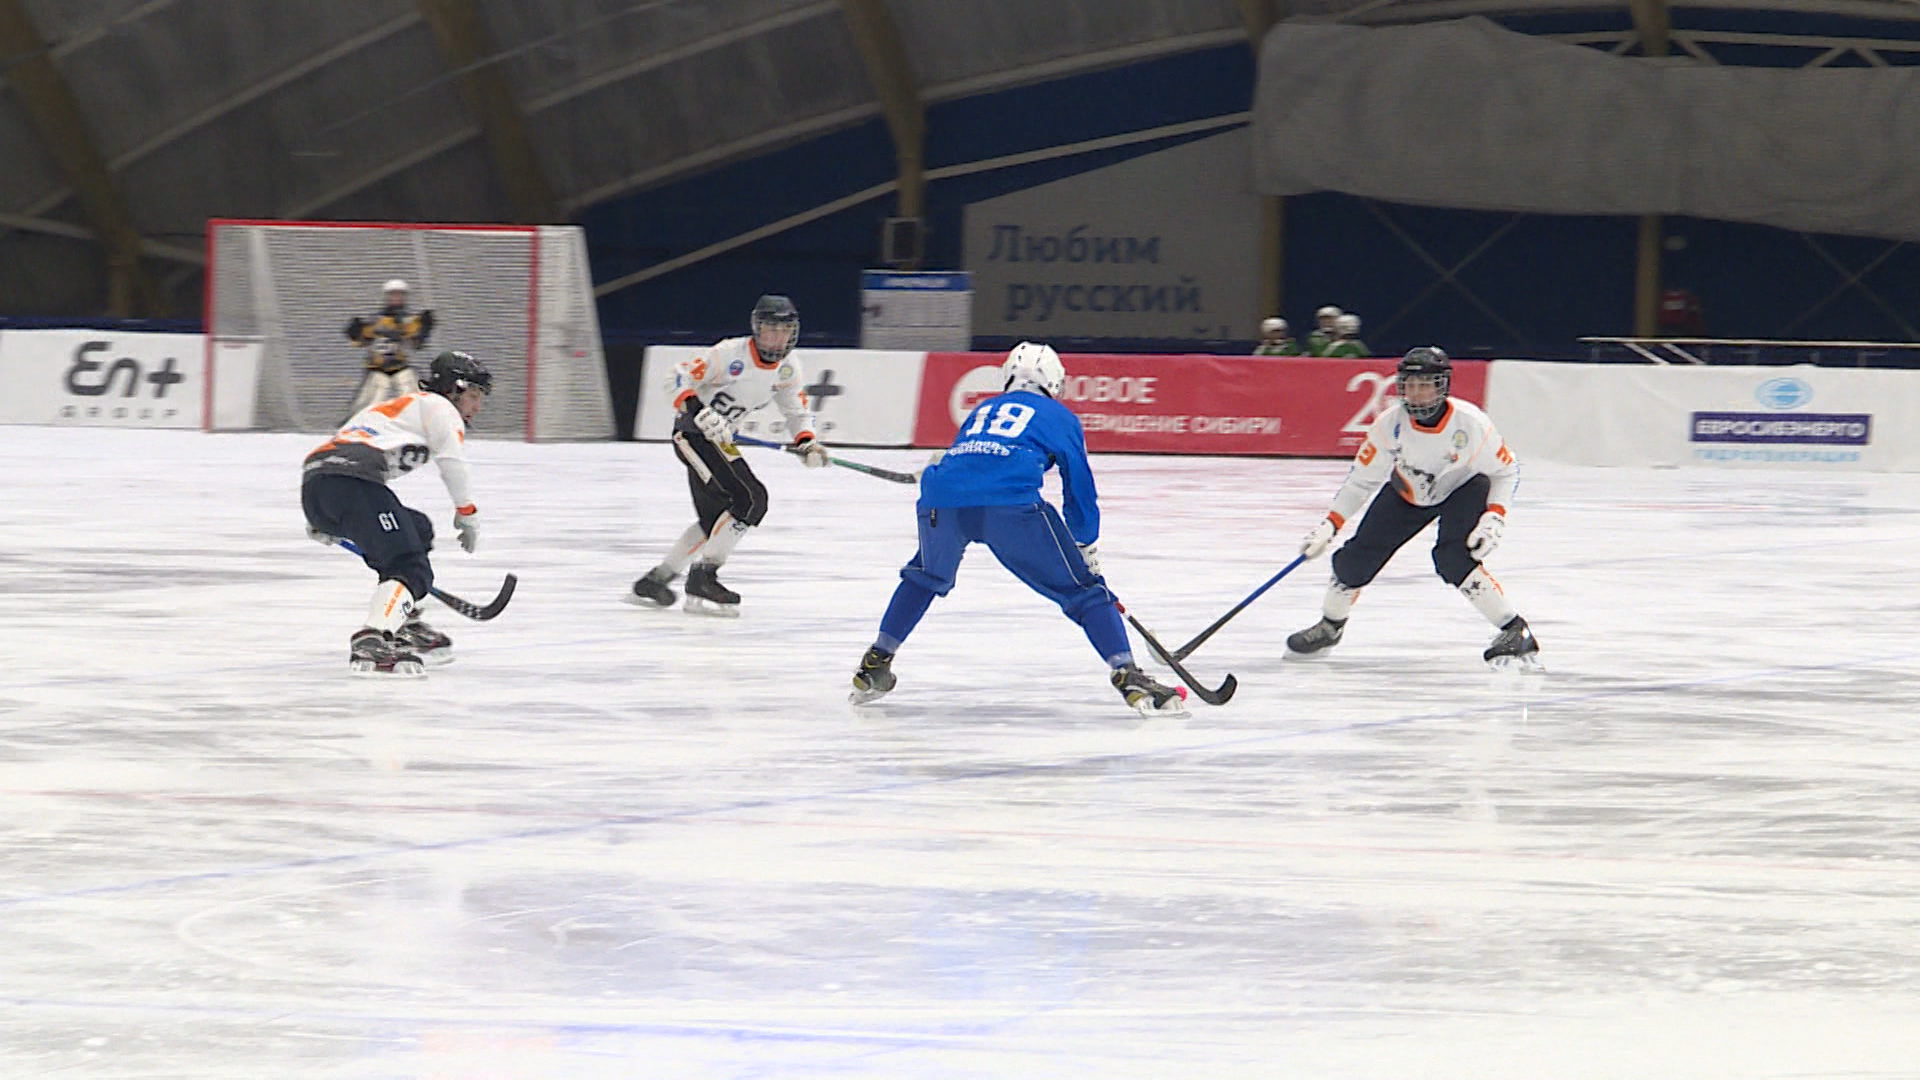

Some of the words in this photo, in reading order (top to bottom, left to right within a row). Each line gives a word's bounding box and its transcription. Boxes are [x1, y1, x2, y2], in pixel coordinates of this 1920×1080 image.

[987, 224, 1162, 263] Любим
[1005, 275, 1202, 321] русский
[966, 402, 1035, 438] 18
